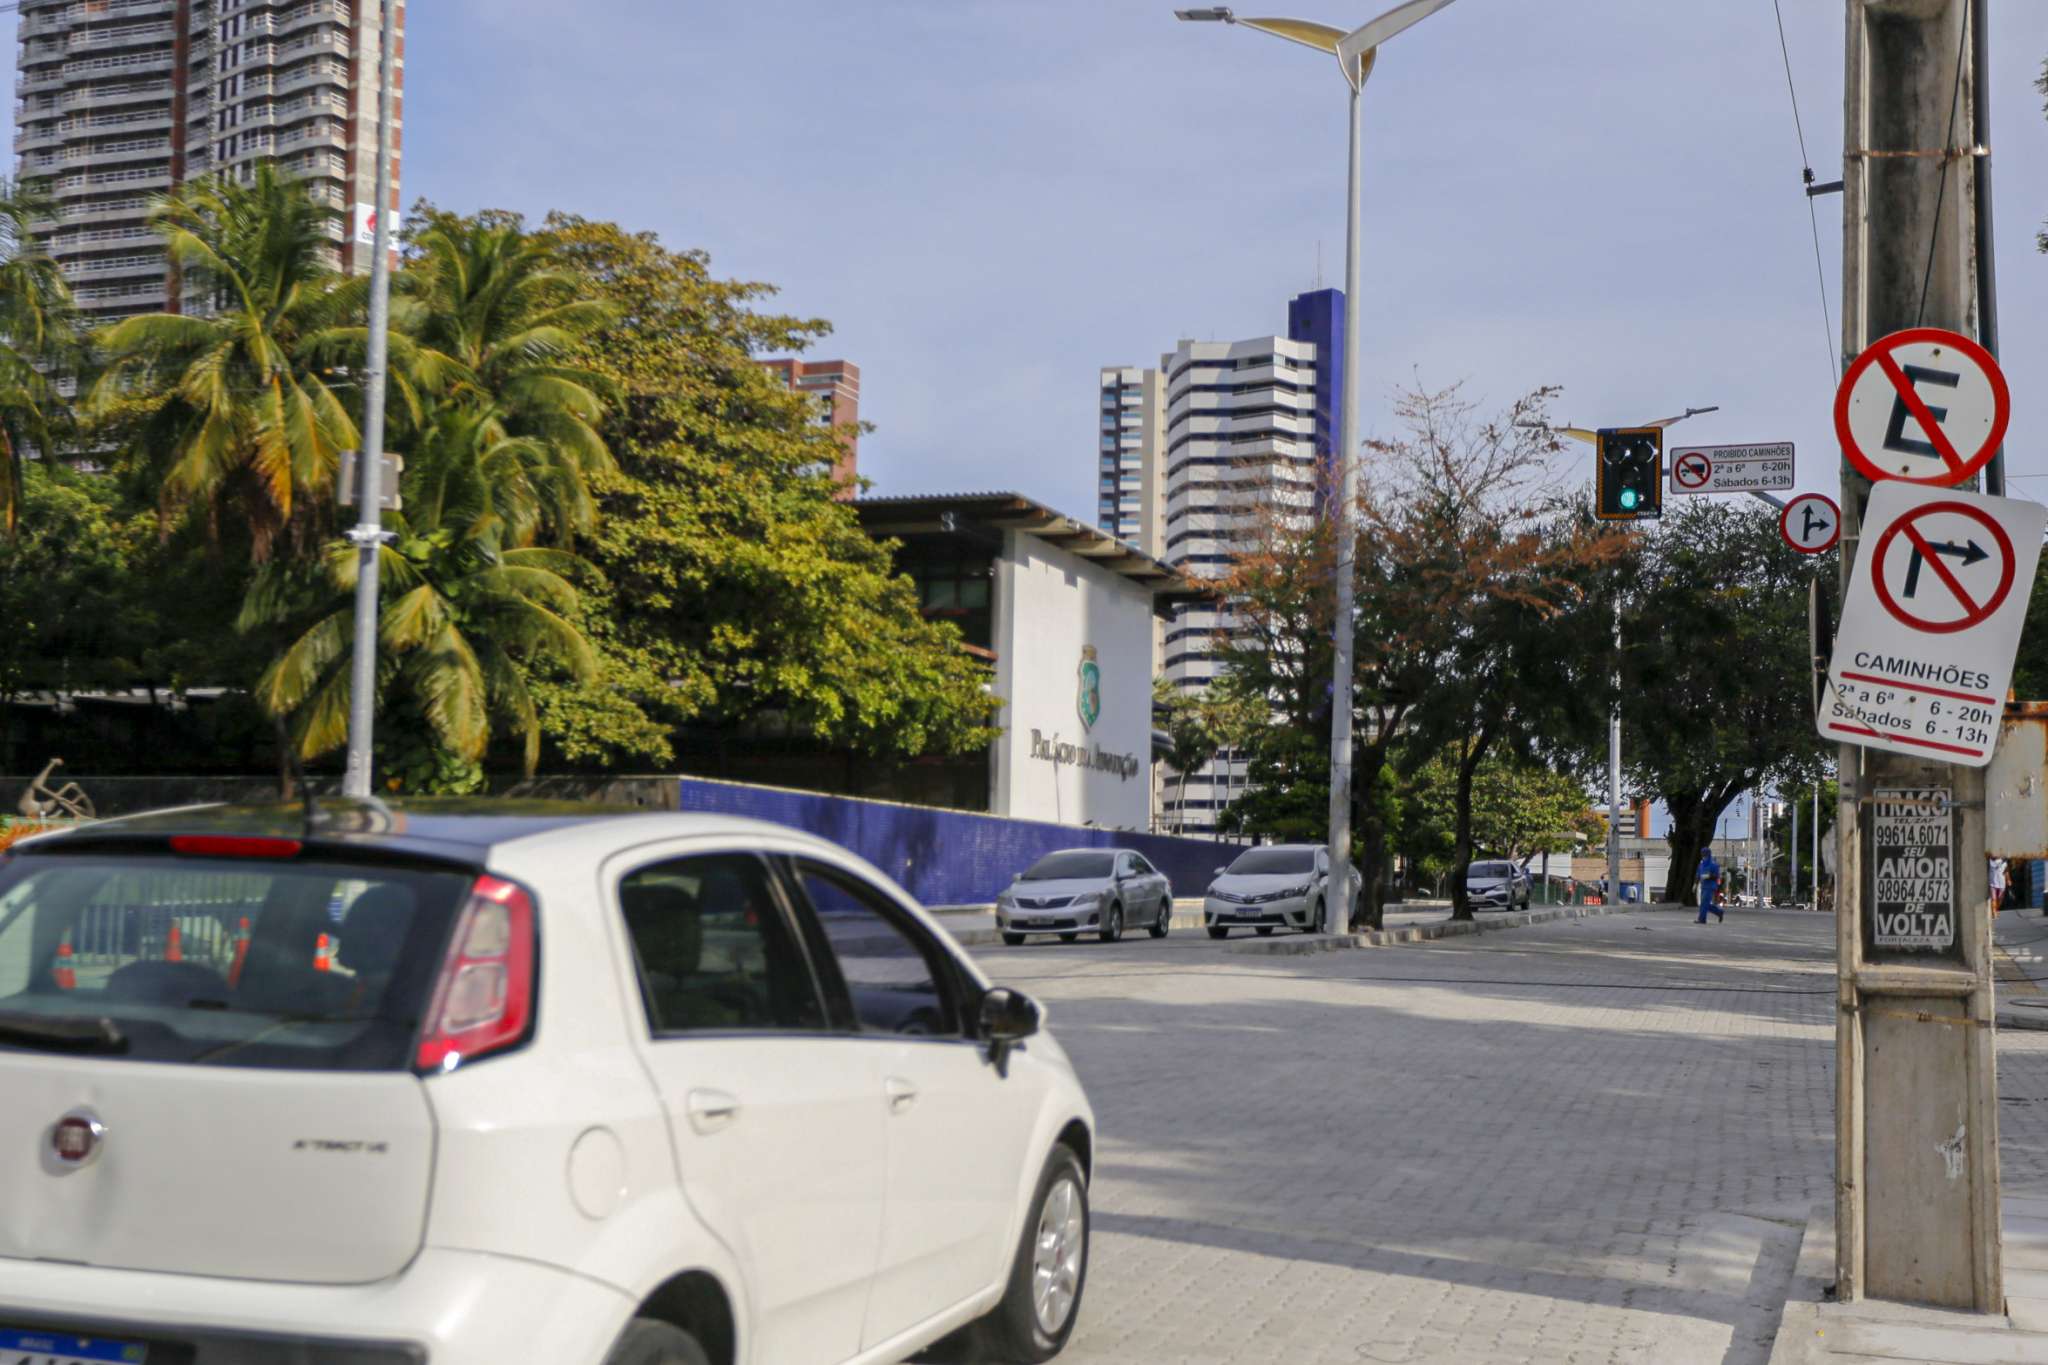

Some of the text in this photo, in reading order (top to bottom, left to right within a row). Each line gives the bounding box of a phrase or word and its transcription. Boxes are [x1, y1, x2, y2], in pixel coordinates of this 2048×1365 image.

[1883, 364, 1961, 459] E
[1713, 446, 1791, 459] PROIBIDO CAMINHÕES
[1726, 465, 1733, 473] a
[1761, 461, 1791, 472] 6-20h
[1713, 475, 1791, 488] Sábados 6-13h
[1854, 652, 1990, 690] CAMINHÕES
[1859, 689, 1870, 703] a
[1831, 702, 1912, 730] Sábados
[1876, 825, 1949, 845] 99614.6071
[1902, 847, 1927, 857] SEU
[1878, 857, 1949, 878] AMOR
[1877, 880, 1950, 901] 98964.4573
[1904, 903, 1925, 913] DE
[1878, 913, 1950, 936] VOLTA
